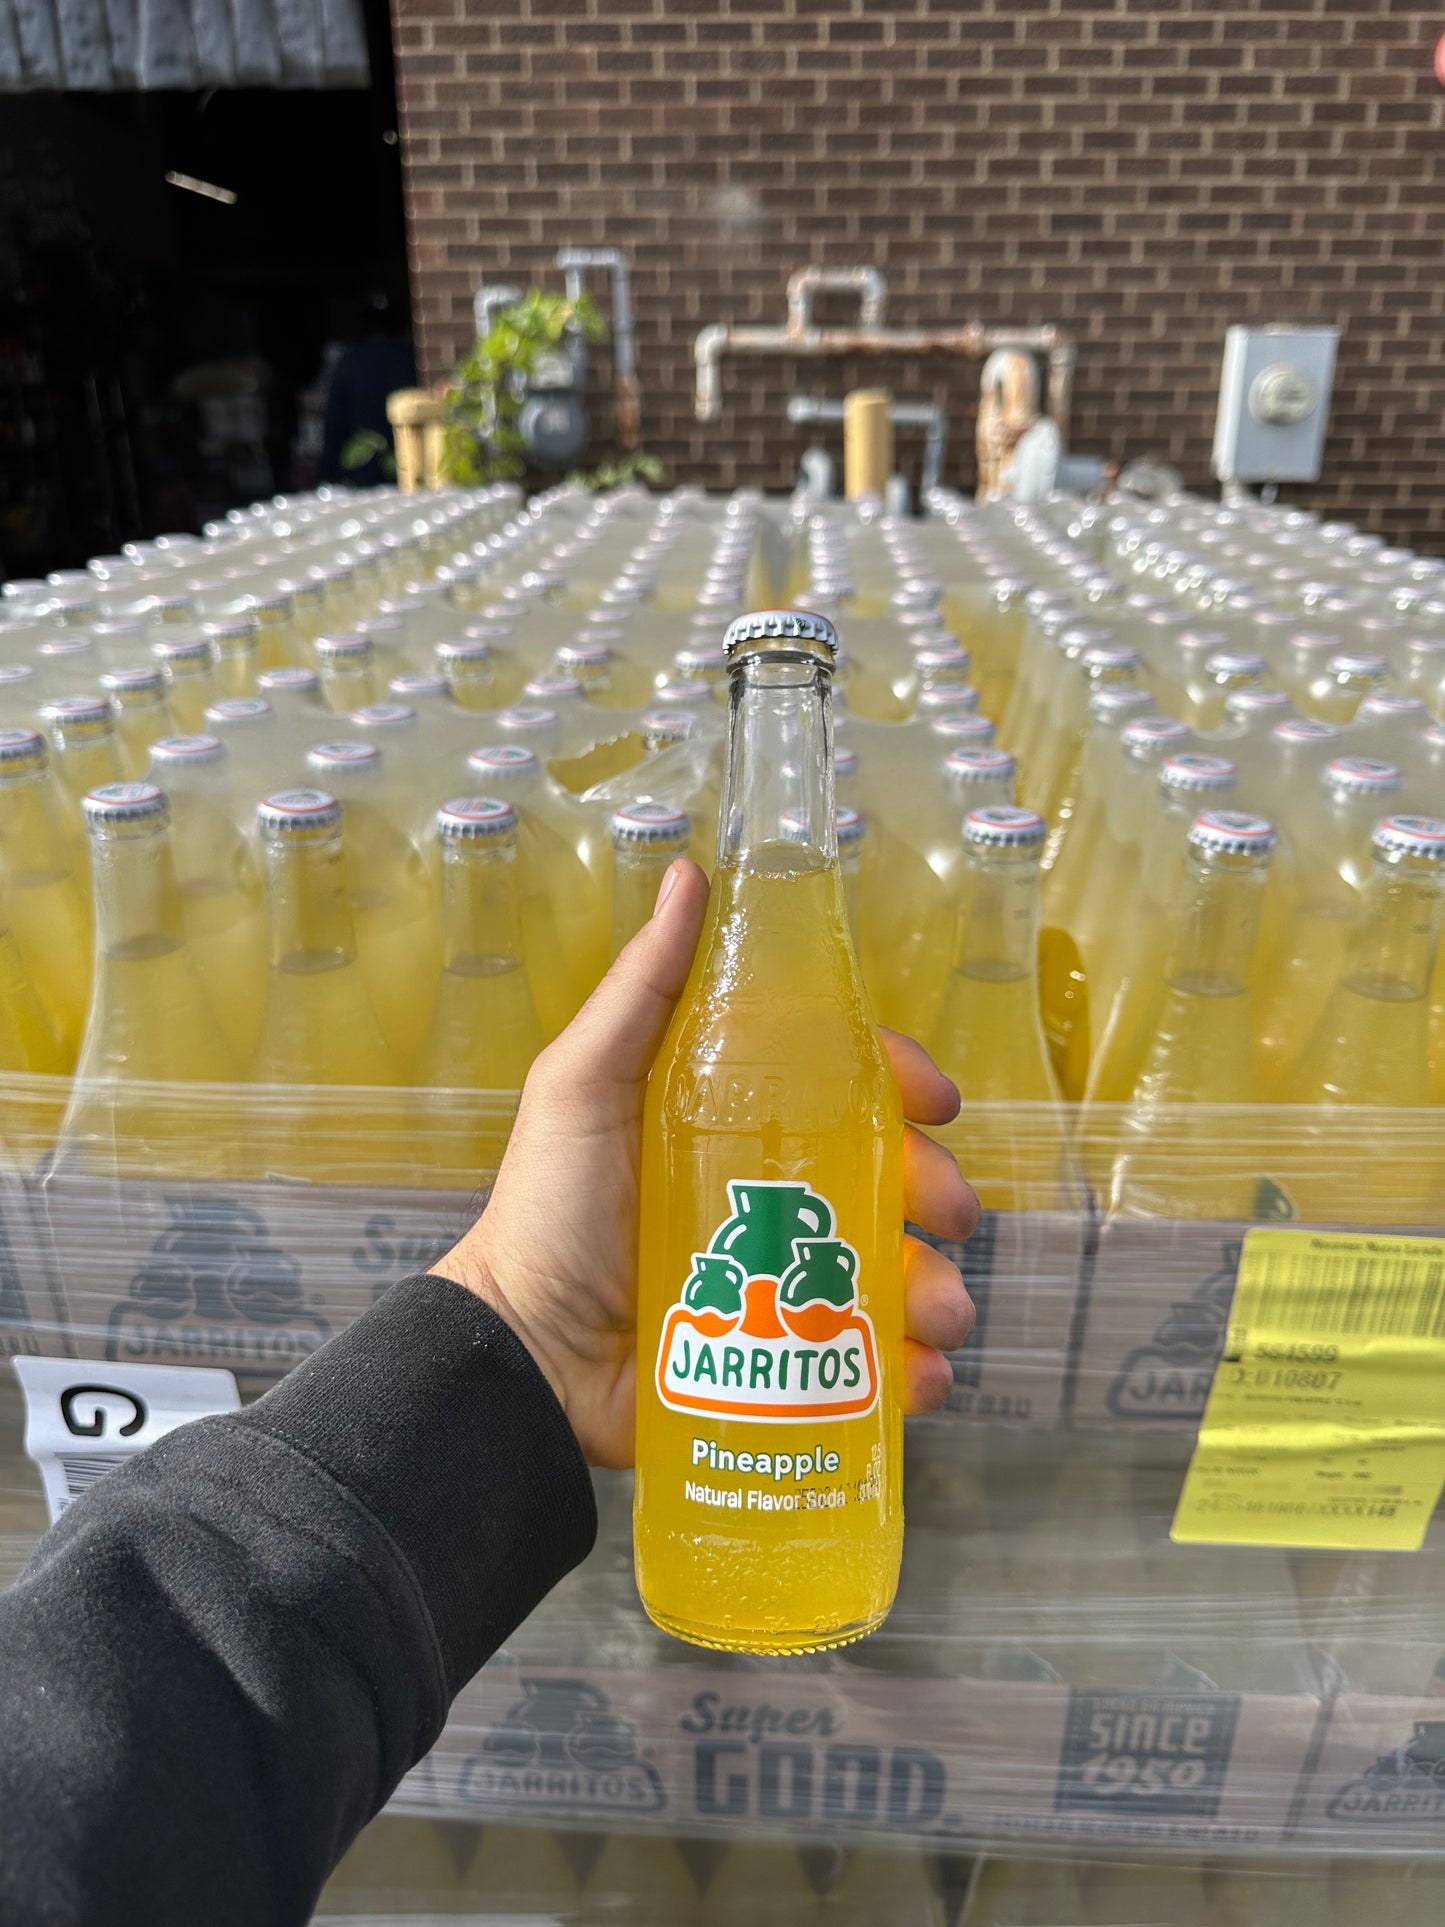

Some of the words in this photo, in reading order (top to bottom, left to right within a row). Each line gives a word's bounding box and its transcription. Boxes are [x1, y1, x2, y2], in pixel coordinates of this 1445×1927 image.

[672, 1339, 861, 1391] JARRITOS
[691, 1437, 840, 1482] Pineapple
[685, 1480, 742, 1509] Natural
[747, 1490, 801, 1511] Flavor
[806, 1487, 846, 1511] Soda
